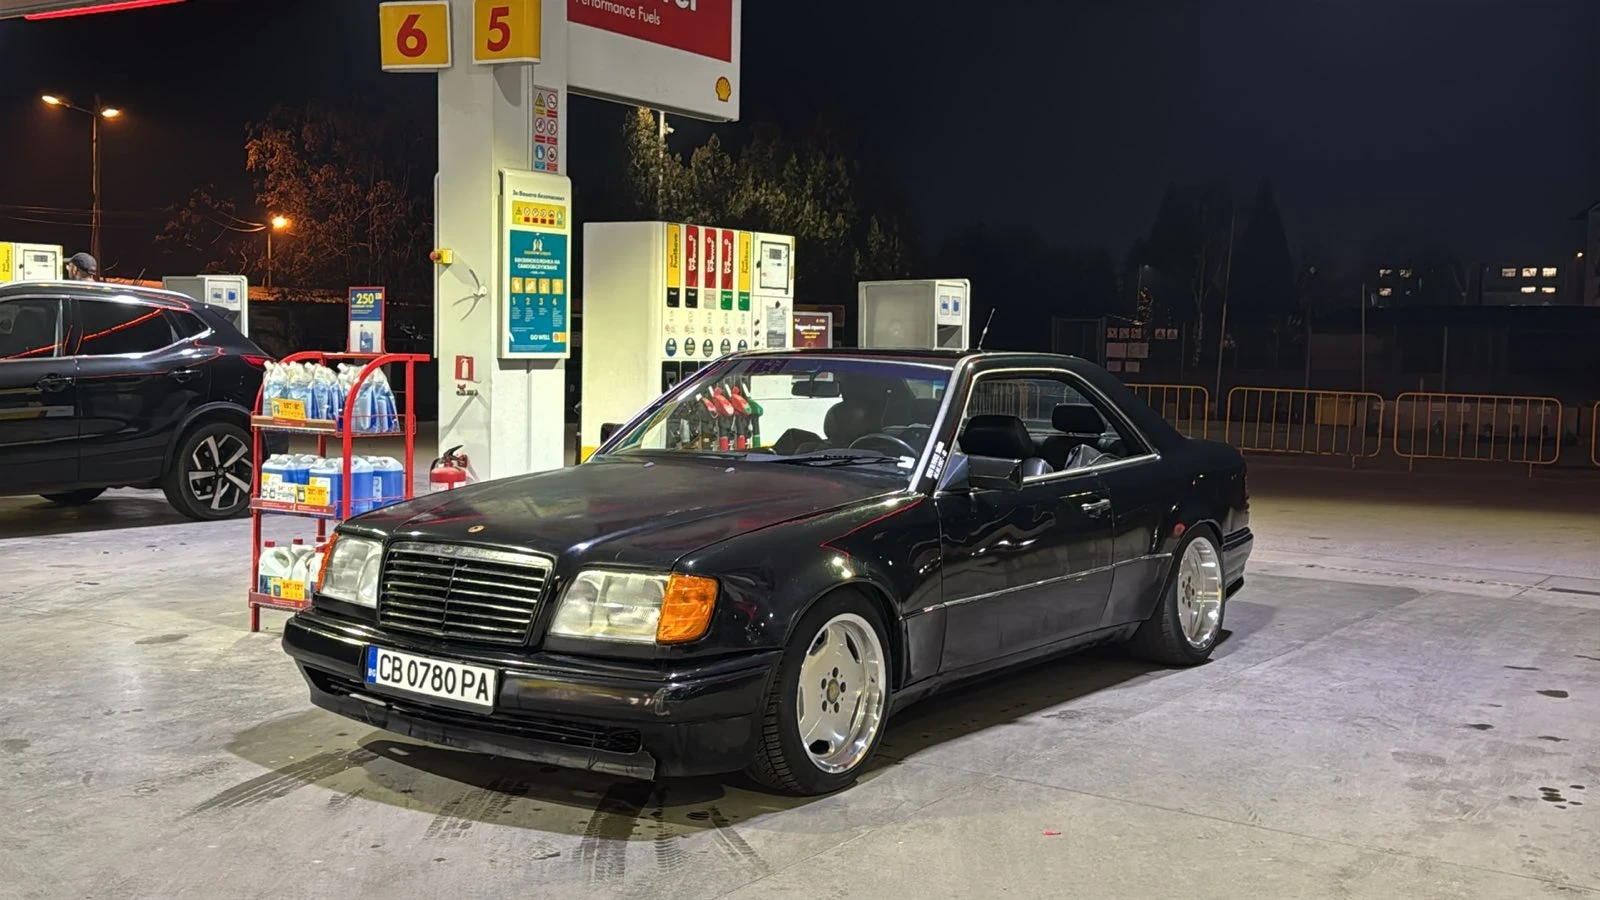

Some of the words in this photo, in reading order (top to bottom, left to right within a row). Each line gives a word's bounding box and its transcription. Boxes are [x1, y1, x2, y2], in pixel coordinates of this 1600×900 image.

[487, 7, 510, 52] 5
[638, 6, 660, 25] Fuels
[397, 14, 427, 57] 6
[356, 292, 374, 305] 250
[525, 297, 531, 306] 2
[538, 297, 544, 306] 3
[552, 297, 557, 306] 4
[380, 654, 403, 683] CB
[407, 659, 456, 694] 0780
[461, 669, 489, 701] PA
